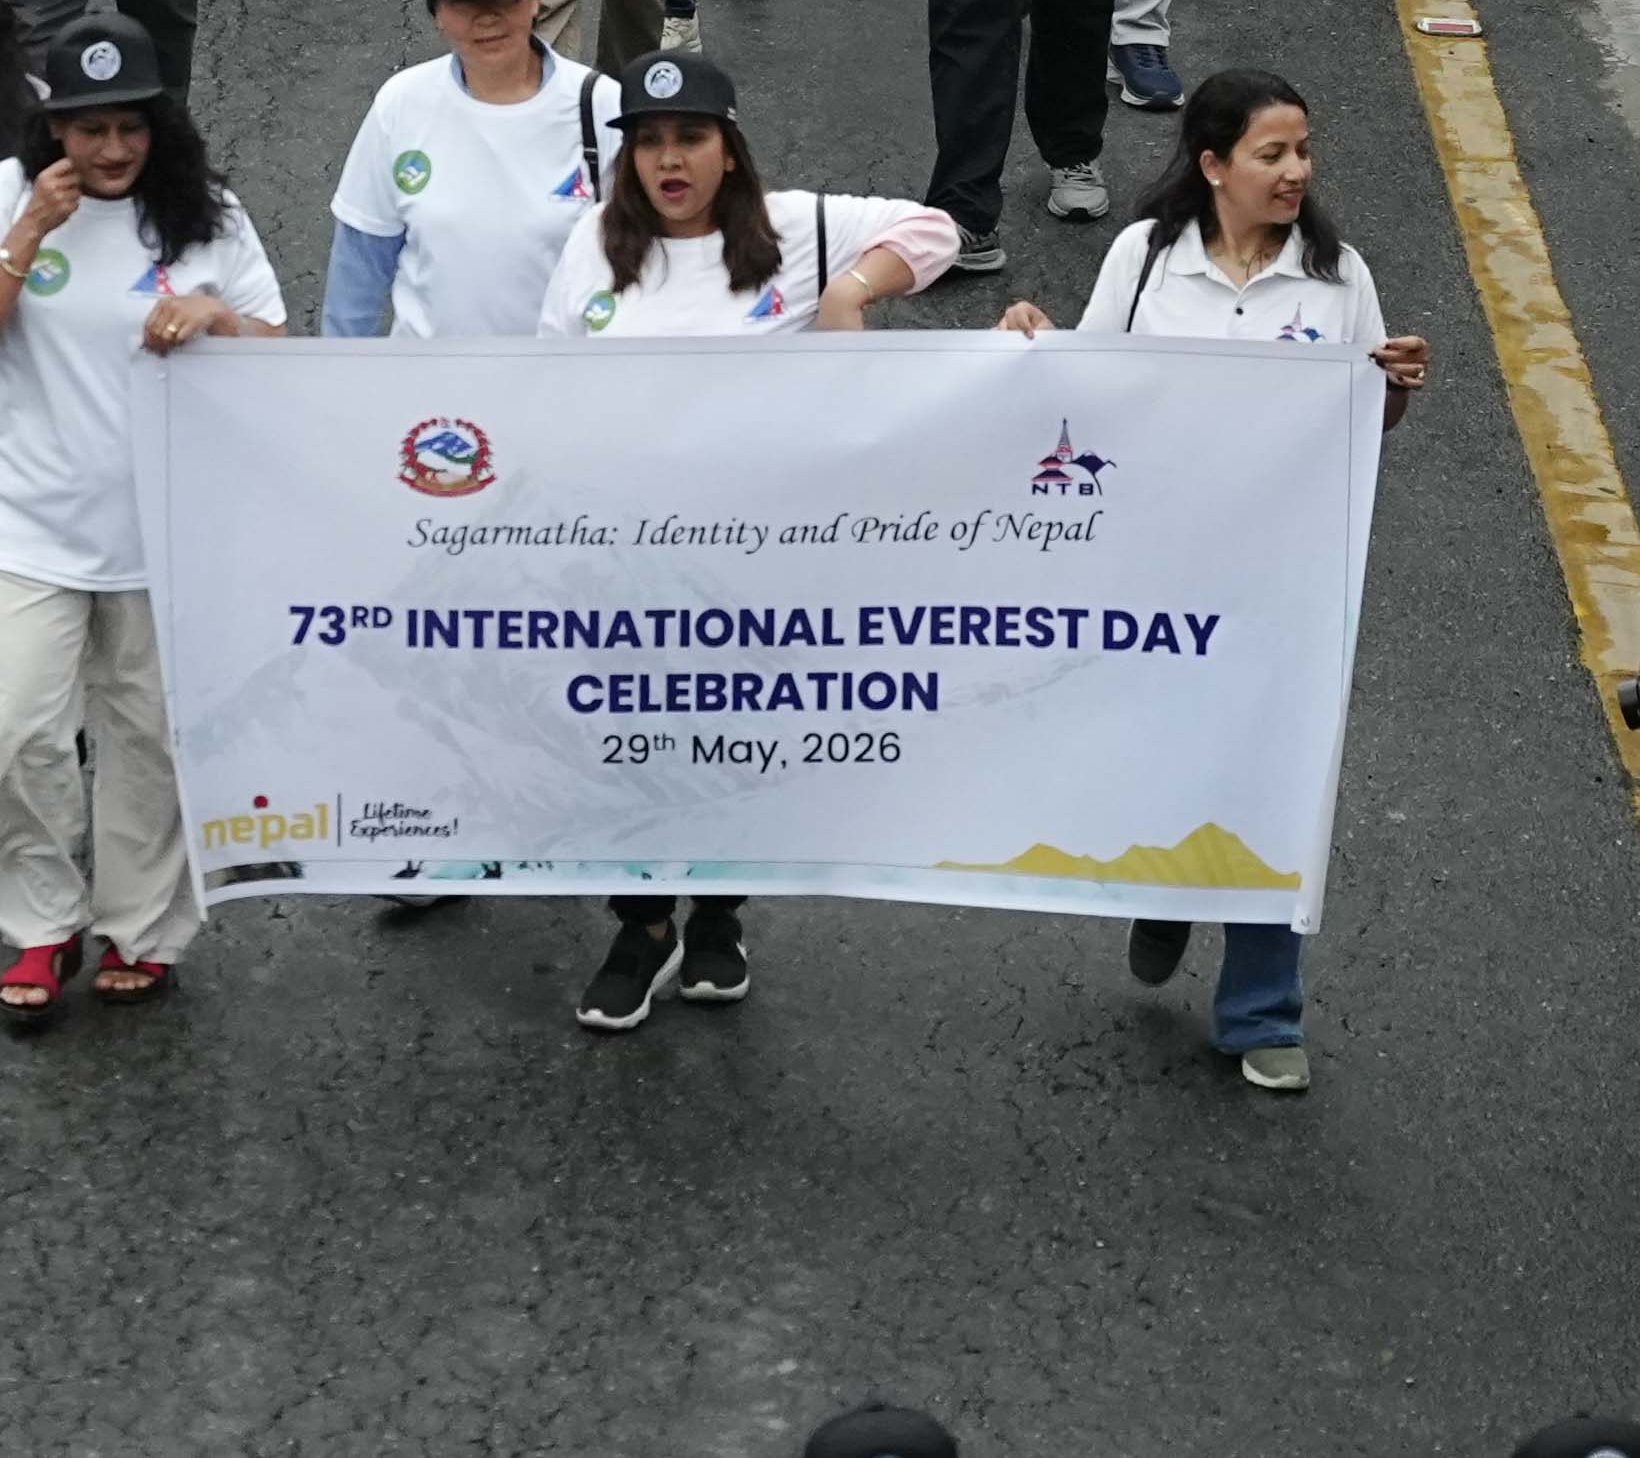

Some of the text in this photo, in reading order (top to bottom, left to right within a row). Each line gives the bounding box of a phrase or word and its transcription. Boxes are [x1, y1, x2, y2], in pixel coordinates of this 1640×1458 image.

[1031, 483, 1095, 496] NTB
[407, 510, 1104, 556] Sagarmatha: Identity and Pride of Nepal
[406, 607, 845, 649] INTERNATIONAL
[858, 606, 1089, 649] EVEREST
[1102, 609, 1221, 656] DAY
[566, 671, 939, 714] CELEBRATION
[602, 731, 901, 774] 29th May, 2026
[202, 802, 432, 850] nepal Lifetime
[349, 817, 460, 843] Experiences!
